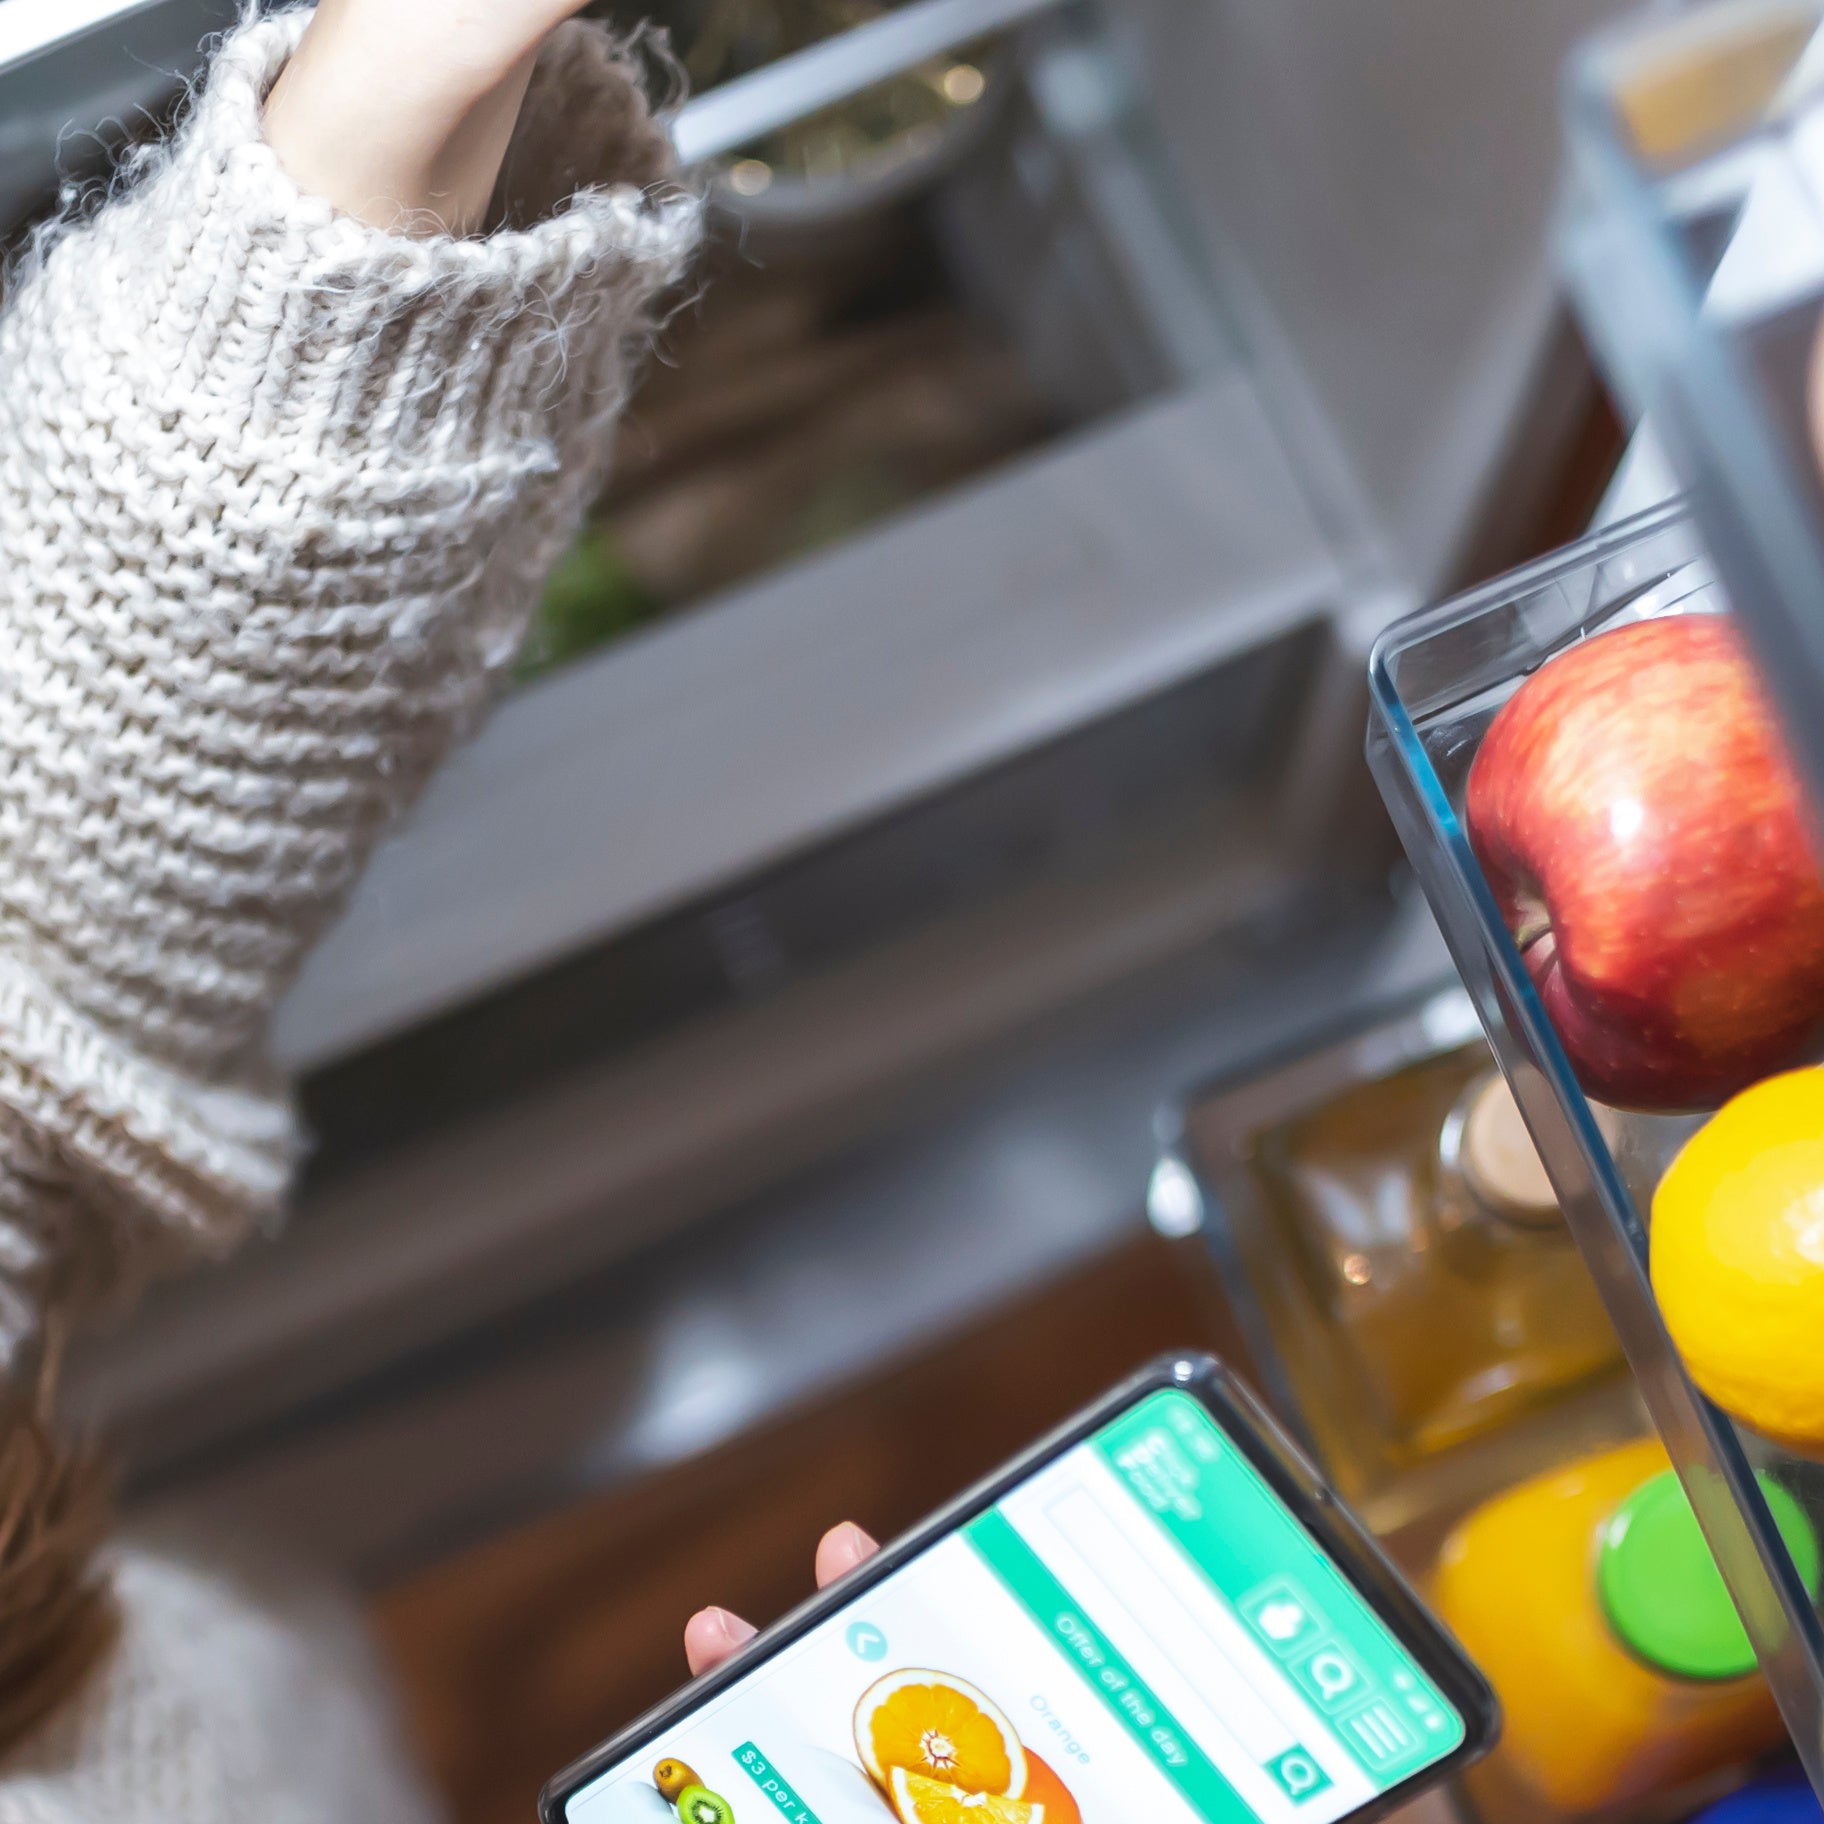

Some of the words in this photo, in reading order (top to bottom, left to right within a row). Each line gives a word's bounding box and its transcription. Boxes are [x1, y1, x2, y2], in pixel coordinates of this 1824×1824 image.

[1057, 1617, 1102, 1665] Offer
[1101, 1671, 1125, 1690] of
[1121, 1693, 1150, 1725] the
[1151, 1730, 1185, 1763] day
[1030, 1695, 1090, 1764] Orange
[741, 1750, 766, 1775] $3
[761, 1779, 796, 1809] per
